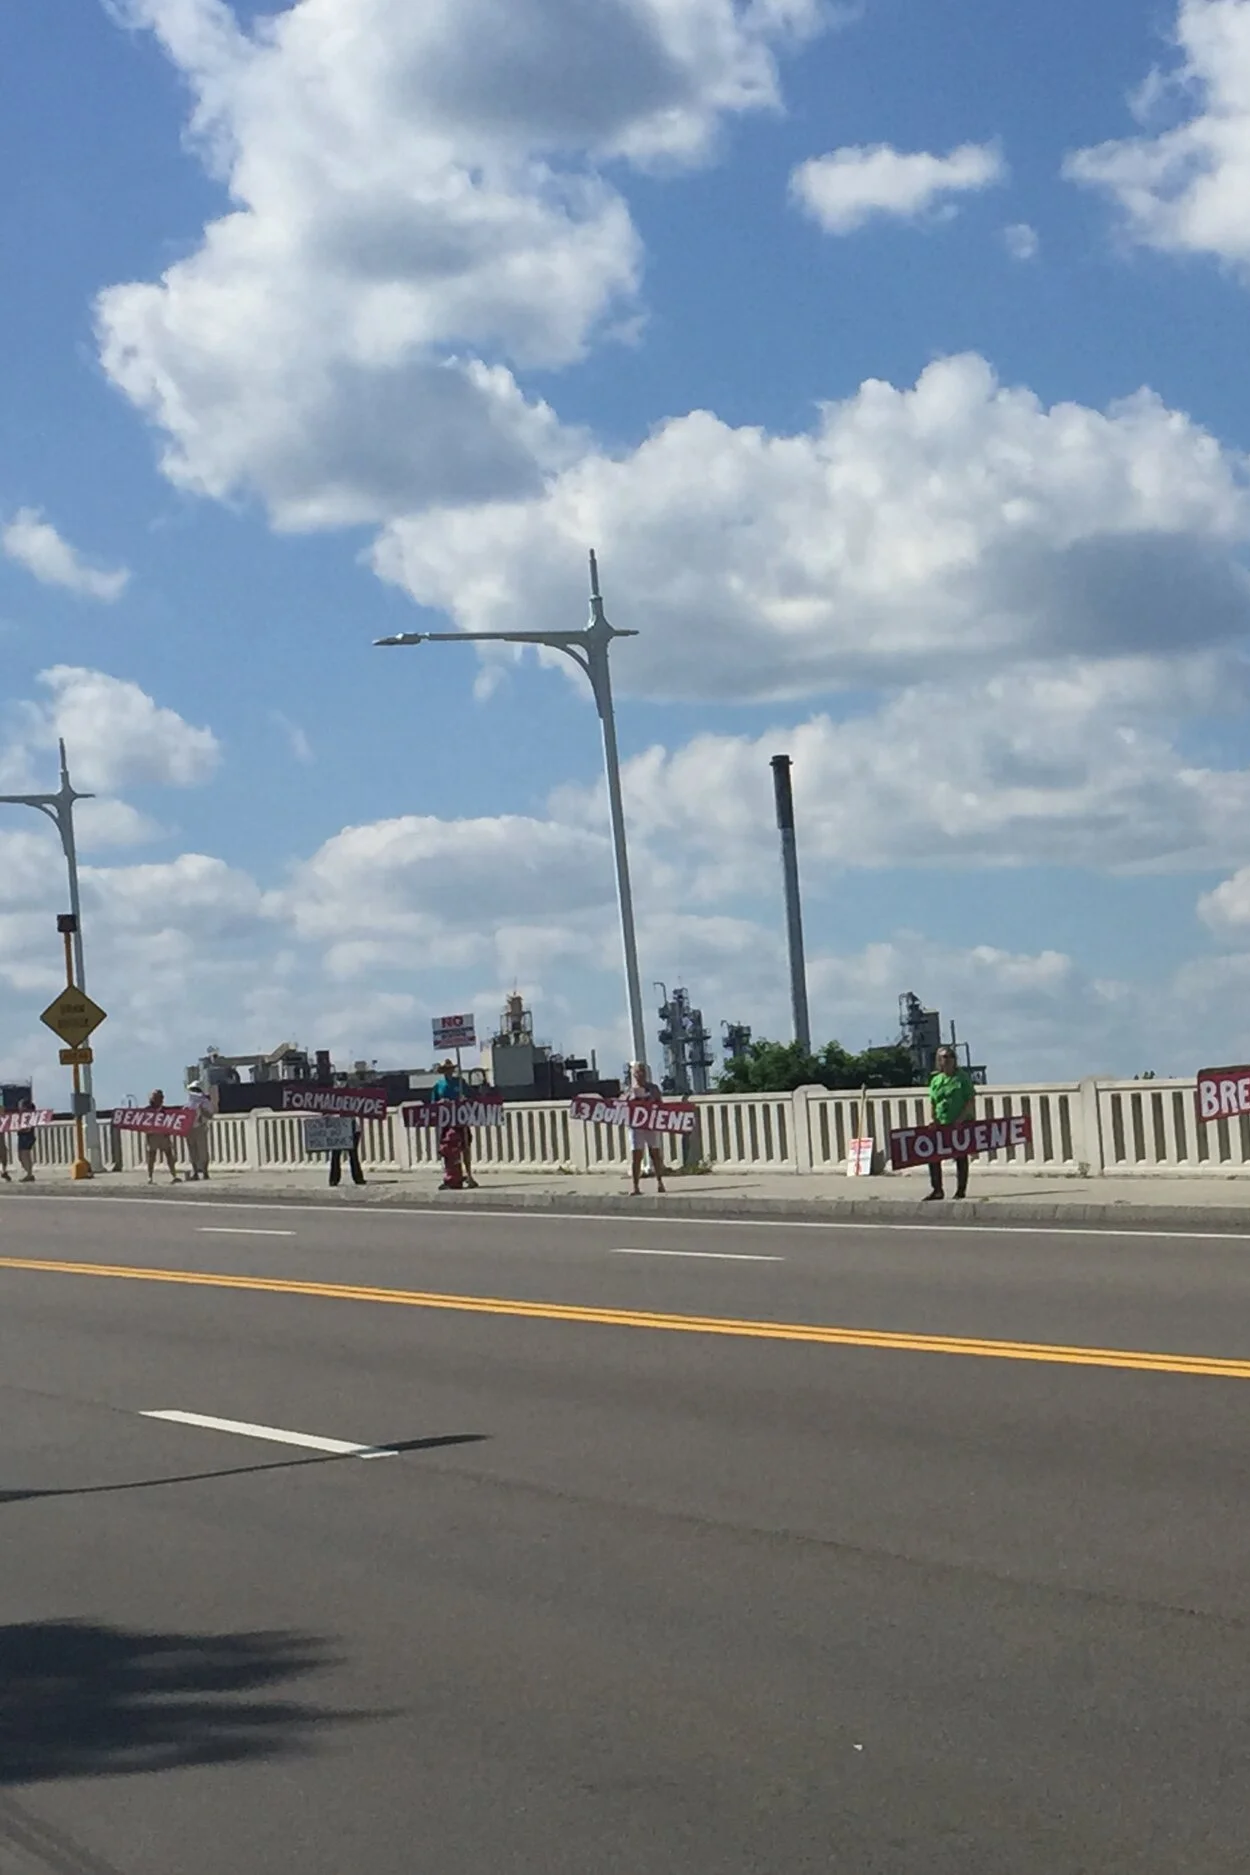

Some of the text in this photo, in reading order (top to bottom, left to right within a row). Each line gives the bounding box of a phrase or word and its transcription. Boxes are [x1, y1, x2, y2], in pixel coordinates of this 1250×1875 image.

[441, 1016, 463, 1028] NO
[113, 1109, 187, 1130] BENZENE
[891, 1118, 1027, 1162] TOLUENE
